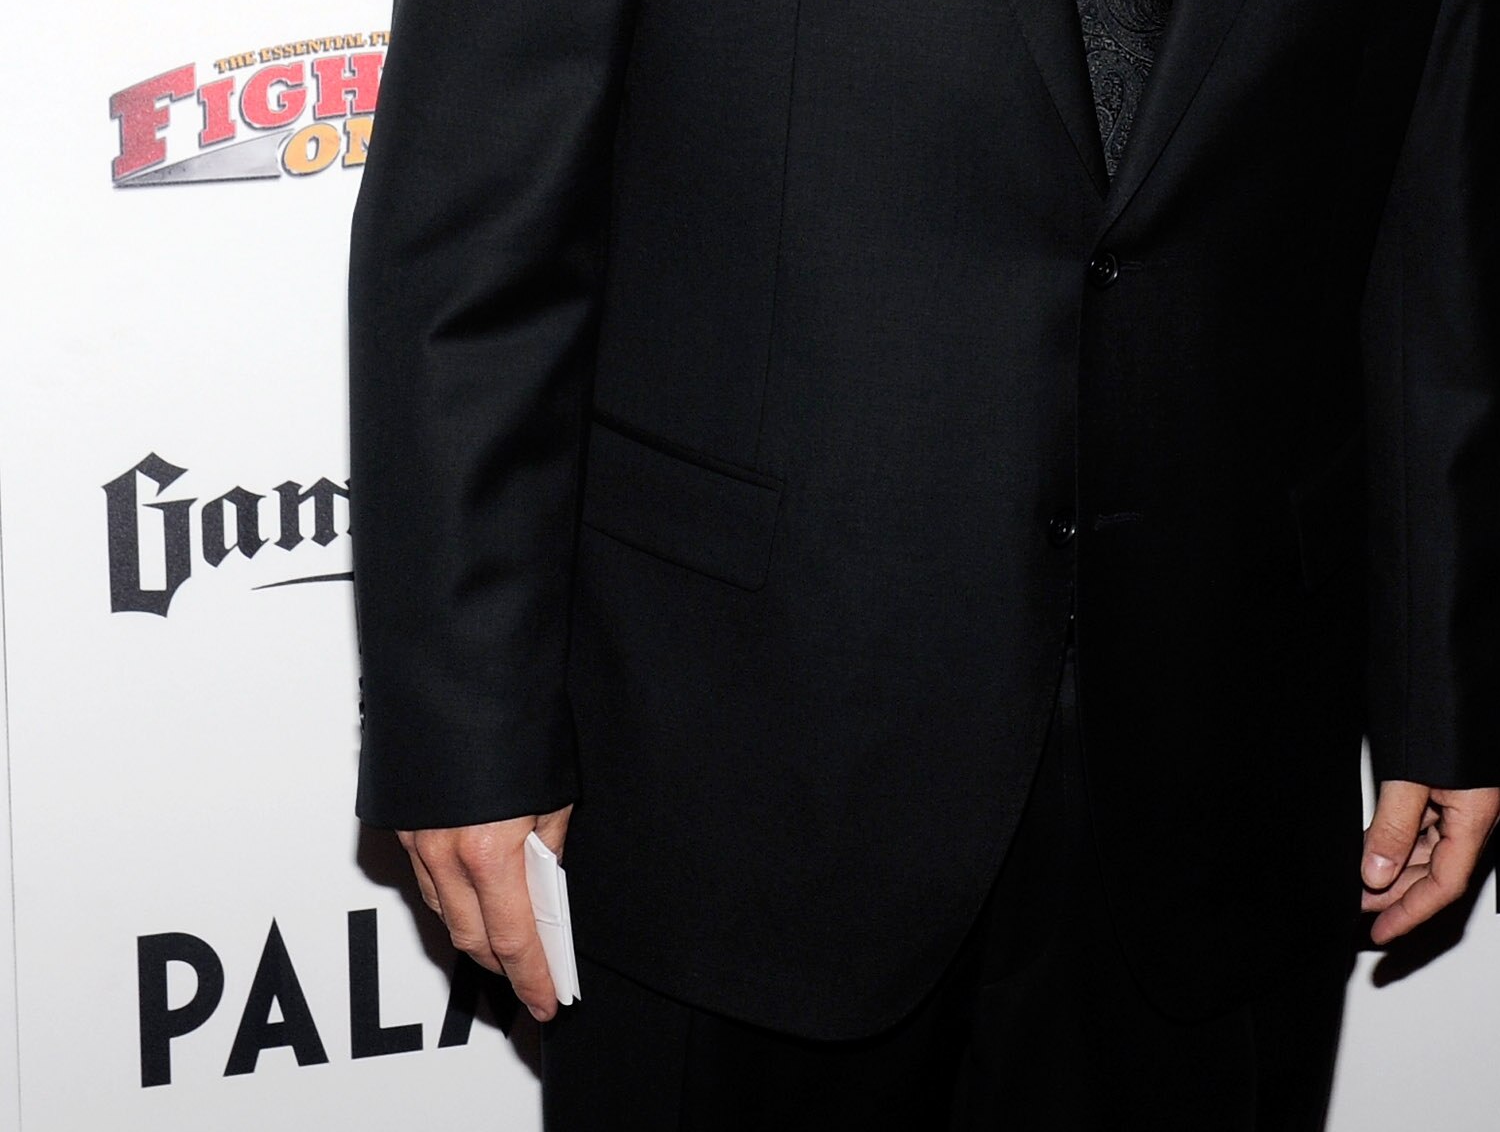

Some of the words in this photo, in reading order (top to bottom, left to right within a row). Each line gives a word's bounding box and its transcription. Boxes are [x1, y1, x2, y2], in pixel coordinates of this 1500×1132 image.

[213, 51, 257, 74] THE
[258, 32, 367, 64] ESSENTIAL
[109, 51, 384, 184] FIGH
